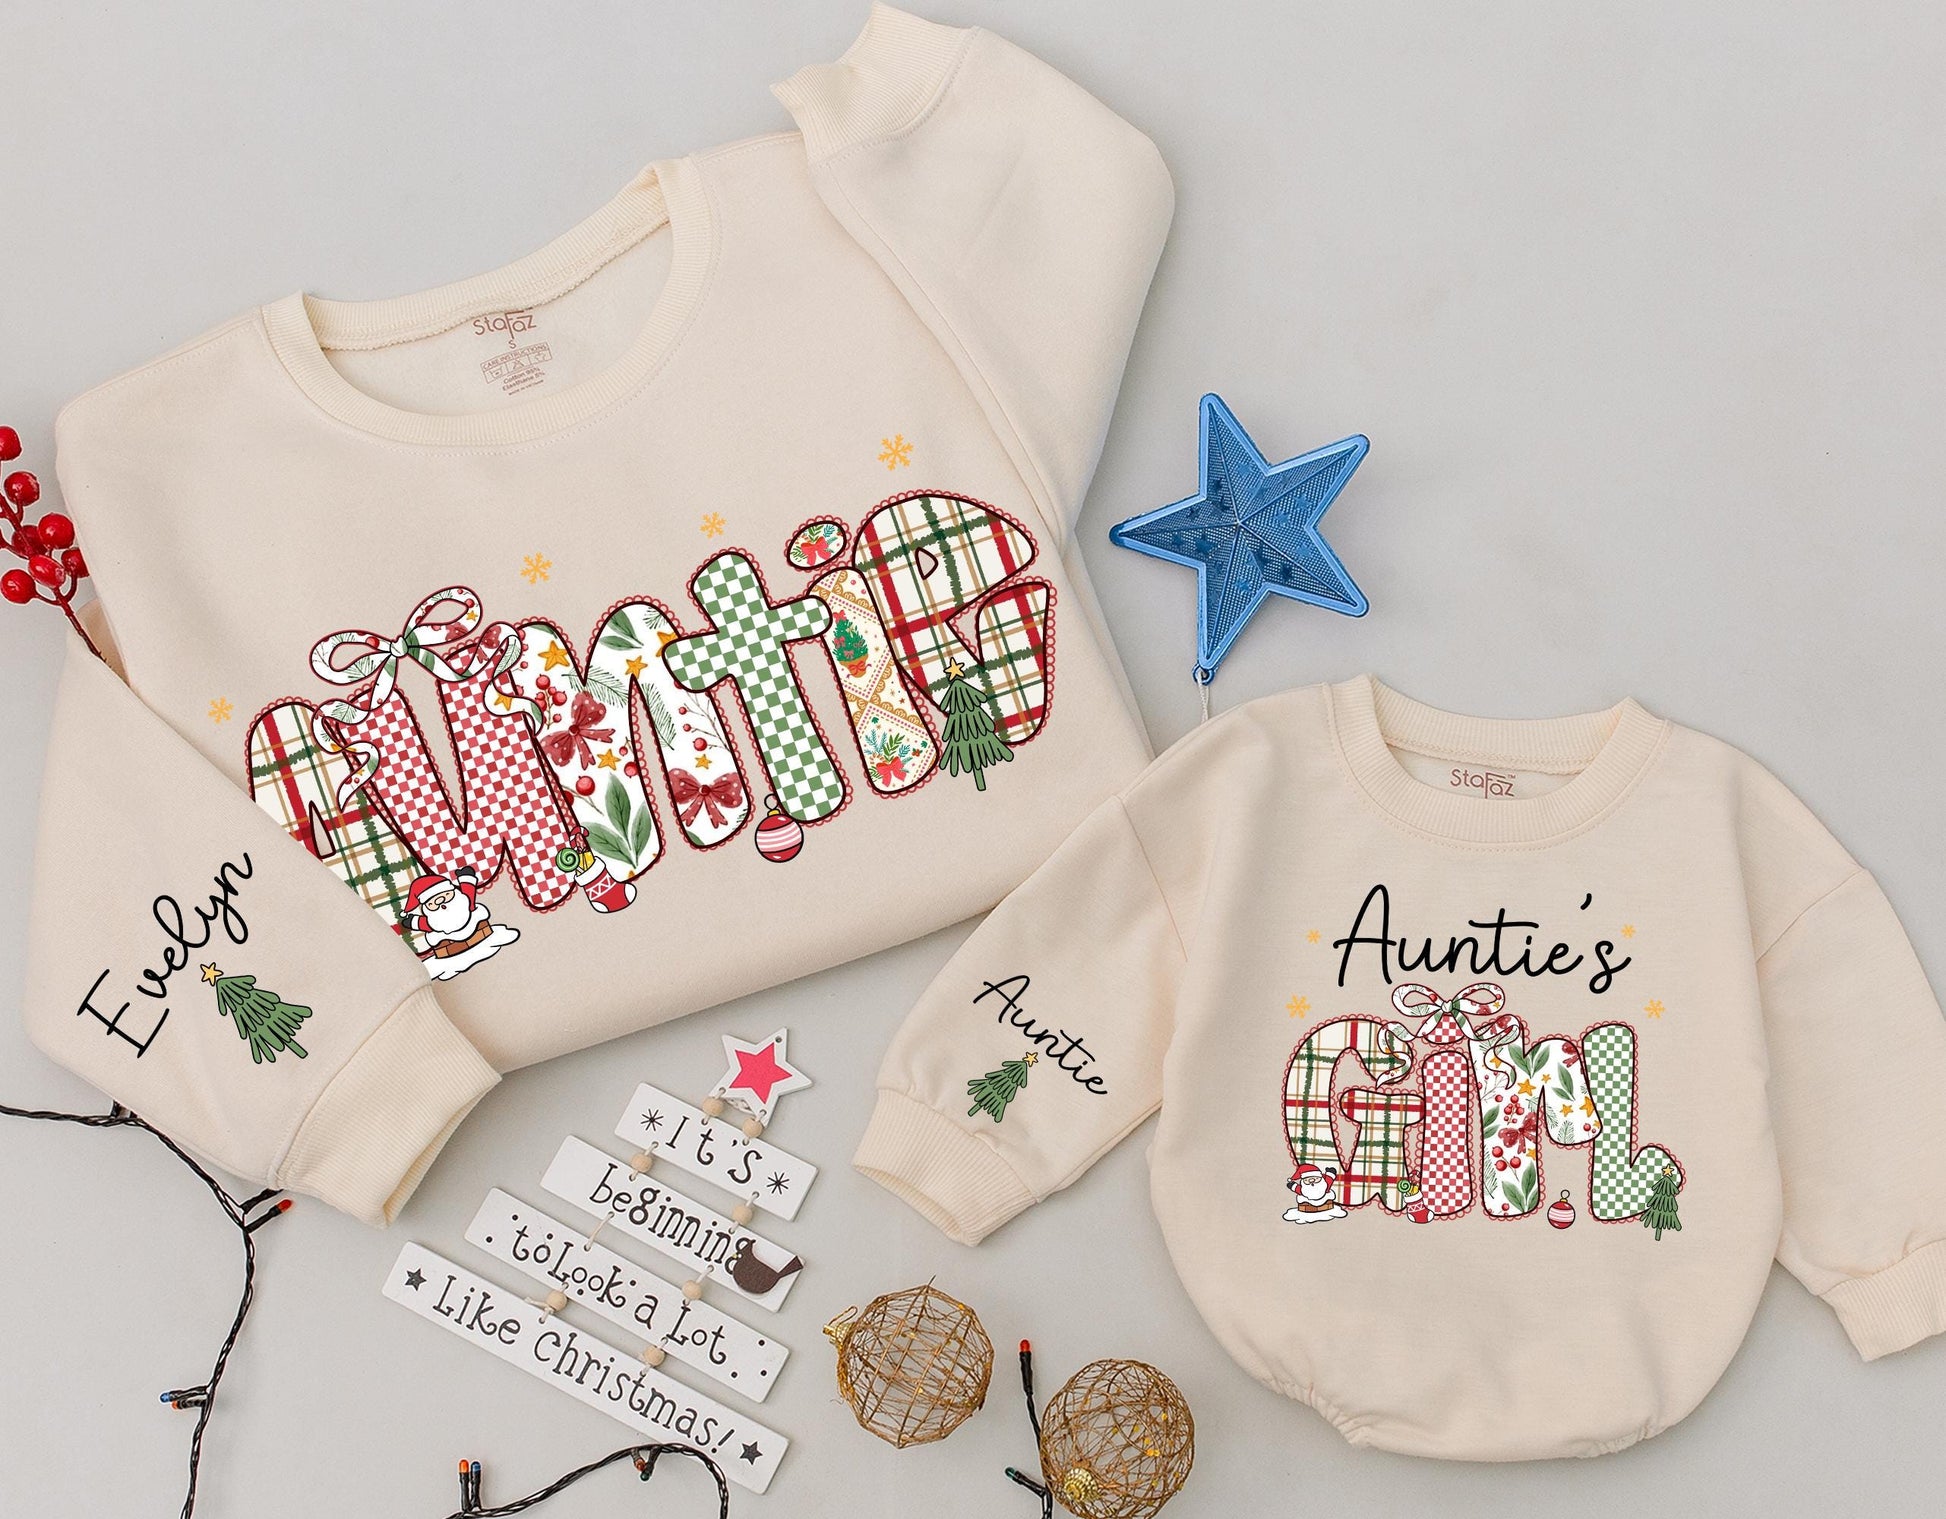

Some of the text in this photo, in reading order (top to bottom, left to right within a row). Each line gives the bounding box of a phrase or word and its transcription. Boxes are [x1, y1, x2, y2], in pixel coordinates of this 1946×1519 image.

[77, 853, 253, 1058] Evelyn
[1333, 885, 1632, 994] Auntie's
[973, 975, 1108, 1094] Auntie
[433, 1275, 521, 1345] Like
[634, 1294, 659, 1330] a
